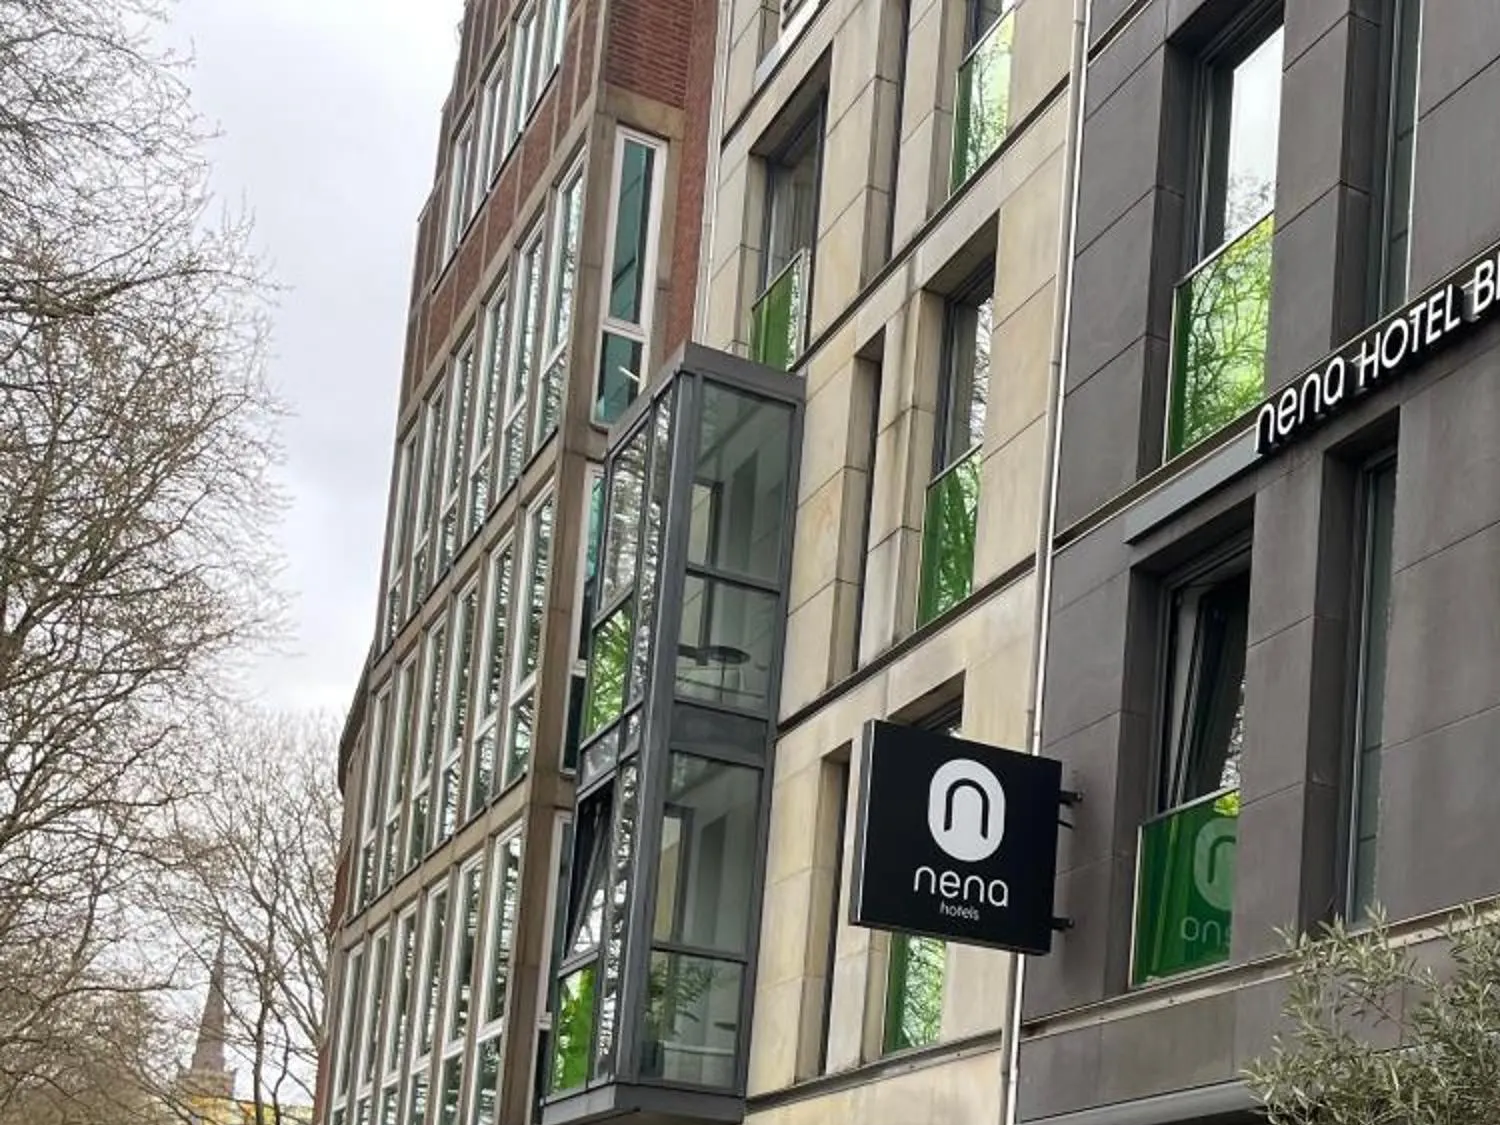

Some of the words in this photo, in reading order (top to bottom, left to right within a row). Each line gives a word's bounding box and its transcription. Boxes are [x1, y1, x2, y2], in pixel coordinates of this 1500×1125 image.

[1255, 356, 1345, 453] nena
[1358, 284, 1461, 388] HOTEL
[913, 866, 1009, 908] nena
[939, 900, 980, 922] hotels
